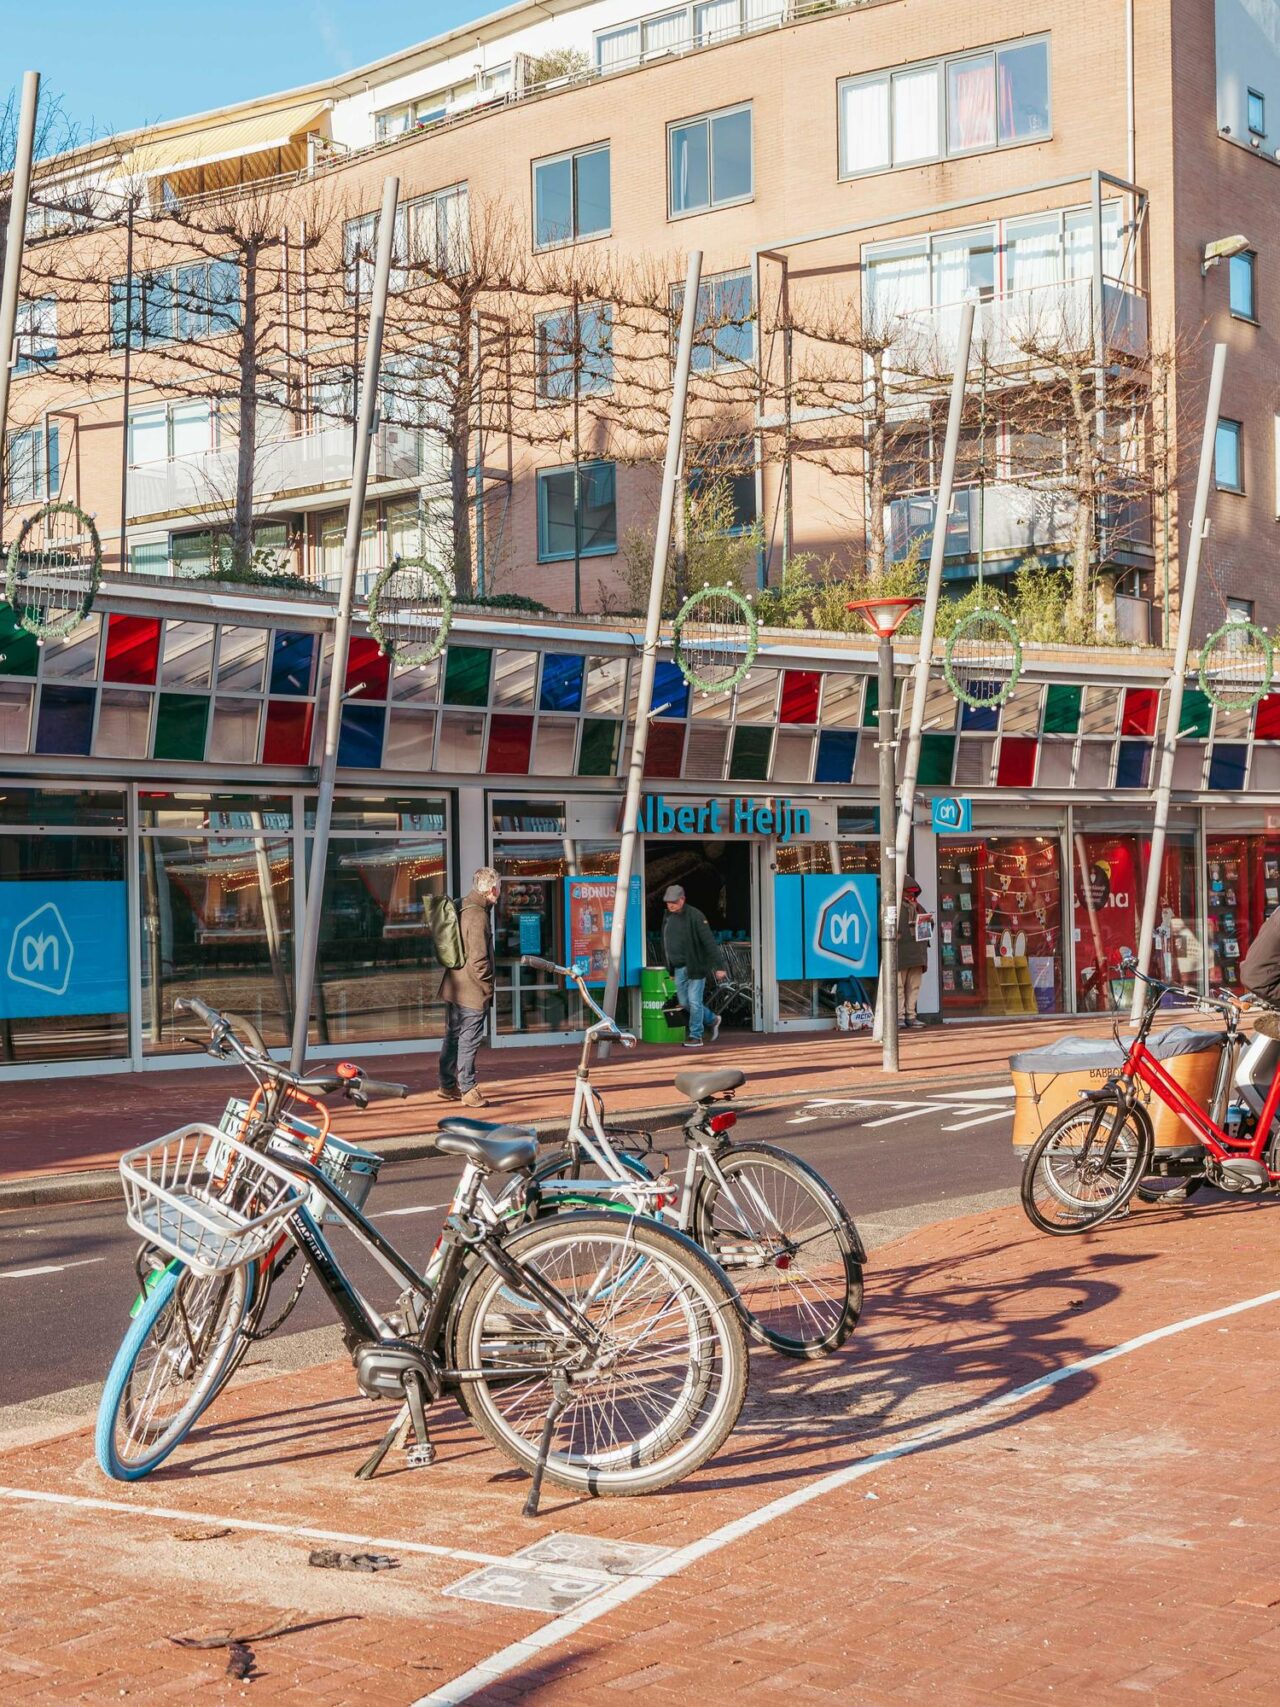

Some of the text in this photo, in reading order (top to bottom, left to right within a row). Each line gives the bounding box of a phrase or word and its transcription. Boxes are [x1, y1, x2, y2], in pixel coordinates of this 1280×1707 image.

[735, 797, 811, 843] Heijn
[581, 886, 616, 899] BONUS
[643, 1000, 665, 1010] SCHOON
[1089, 1067, 1124, 1078] BABBO
[293, 1213, 324, 1261] SWAPFIETS
